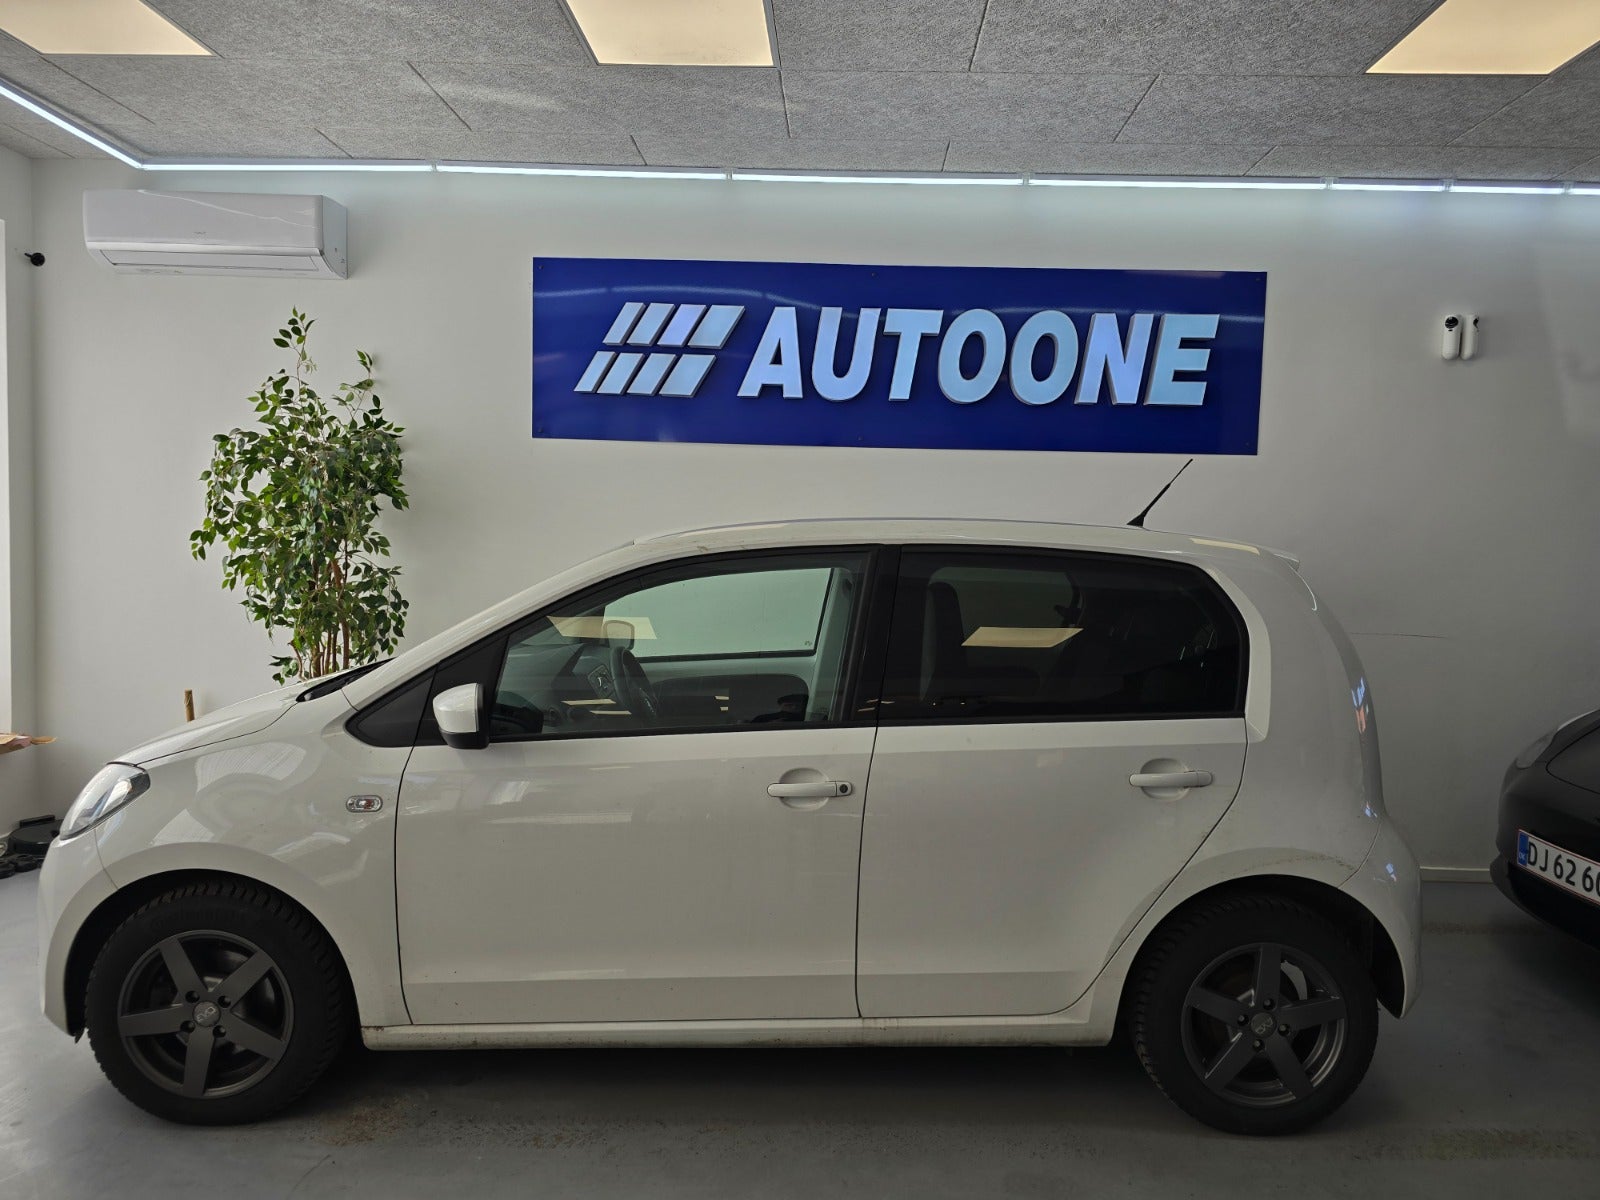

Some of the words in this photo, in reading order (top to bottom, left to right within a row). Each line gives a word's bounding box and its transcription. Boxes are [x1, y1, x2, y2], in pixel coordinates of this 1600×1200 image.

[737, 306, 1220, 407] AUTOONE
[1527, 841, 1549, 872] DJ
[1553, 854, 1577, 887] 62
